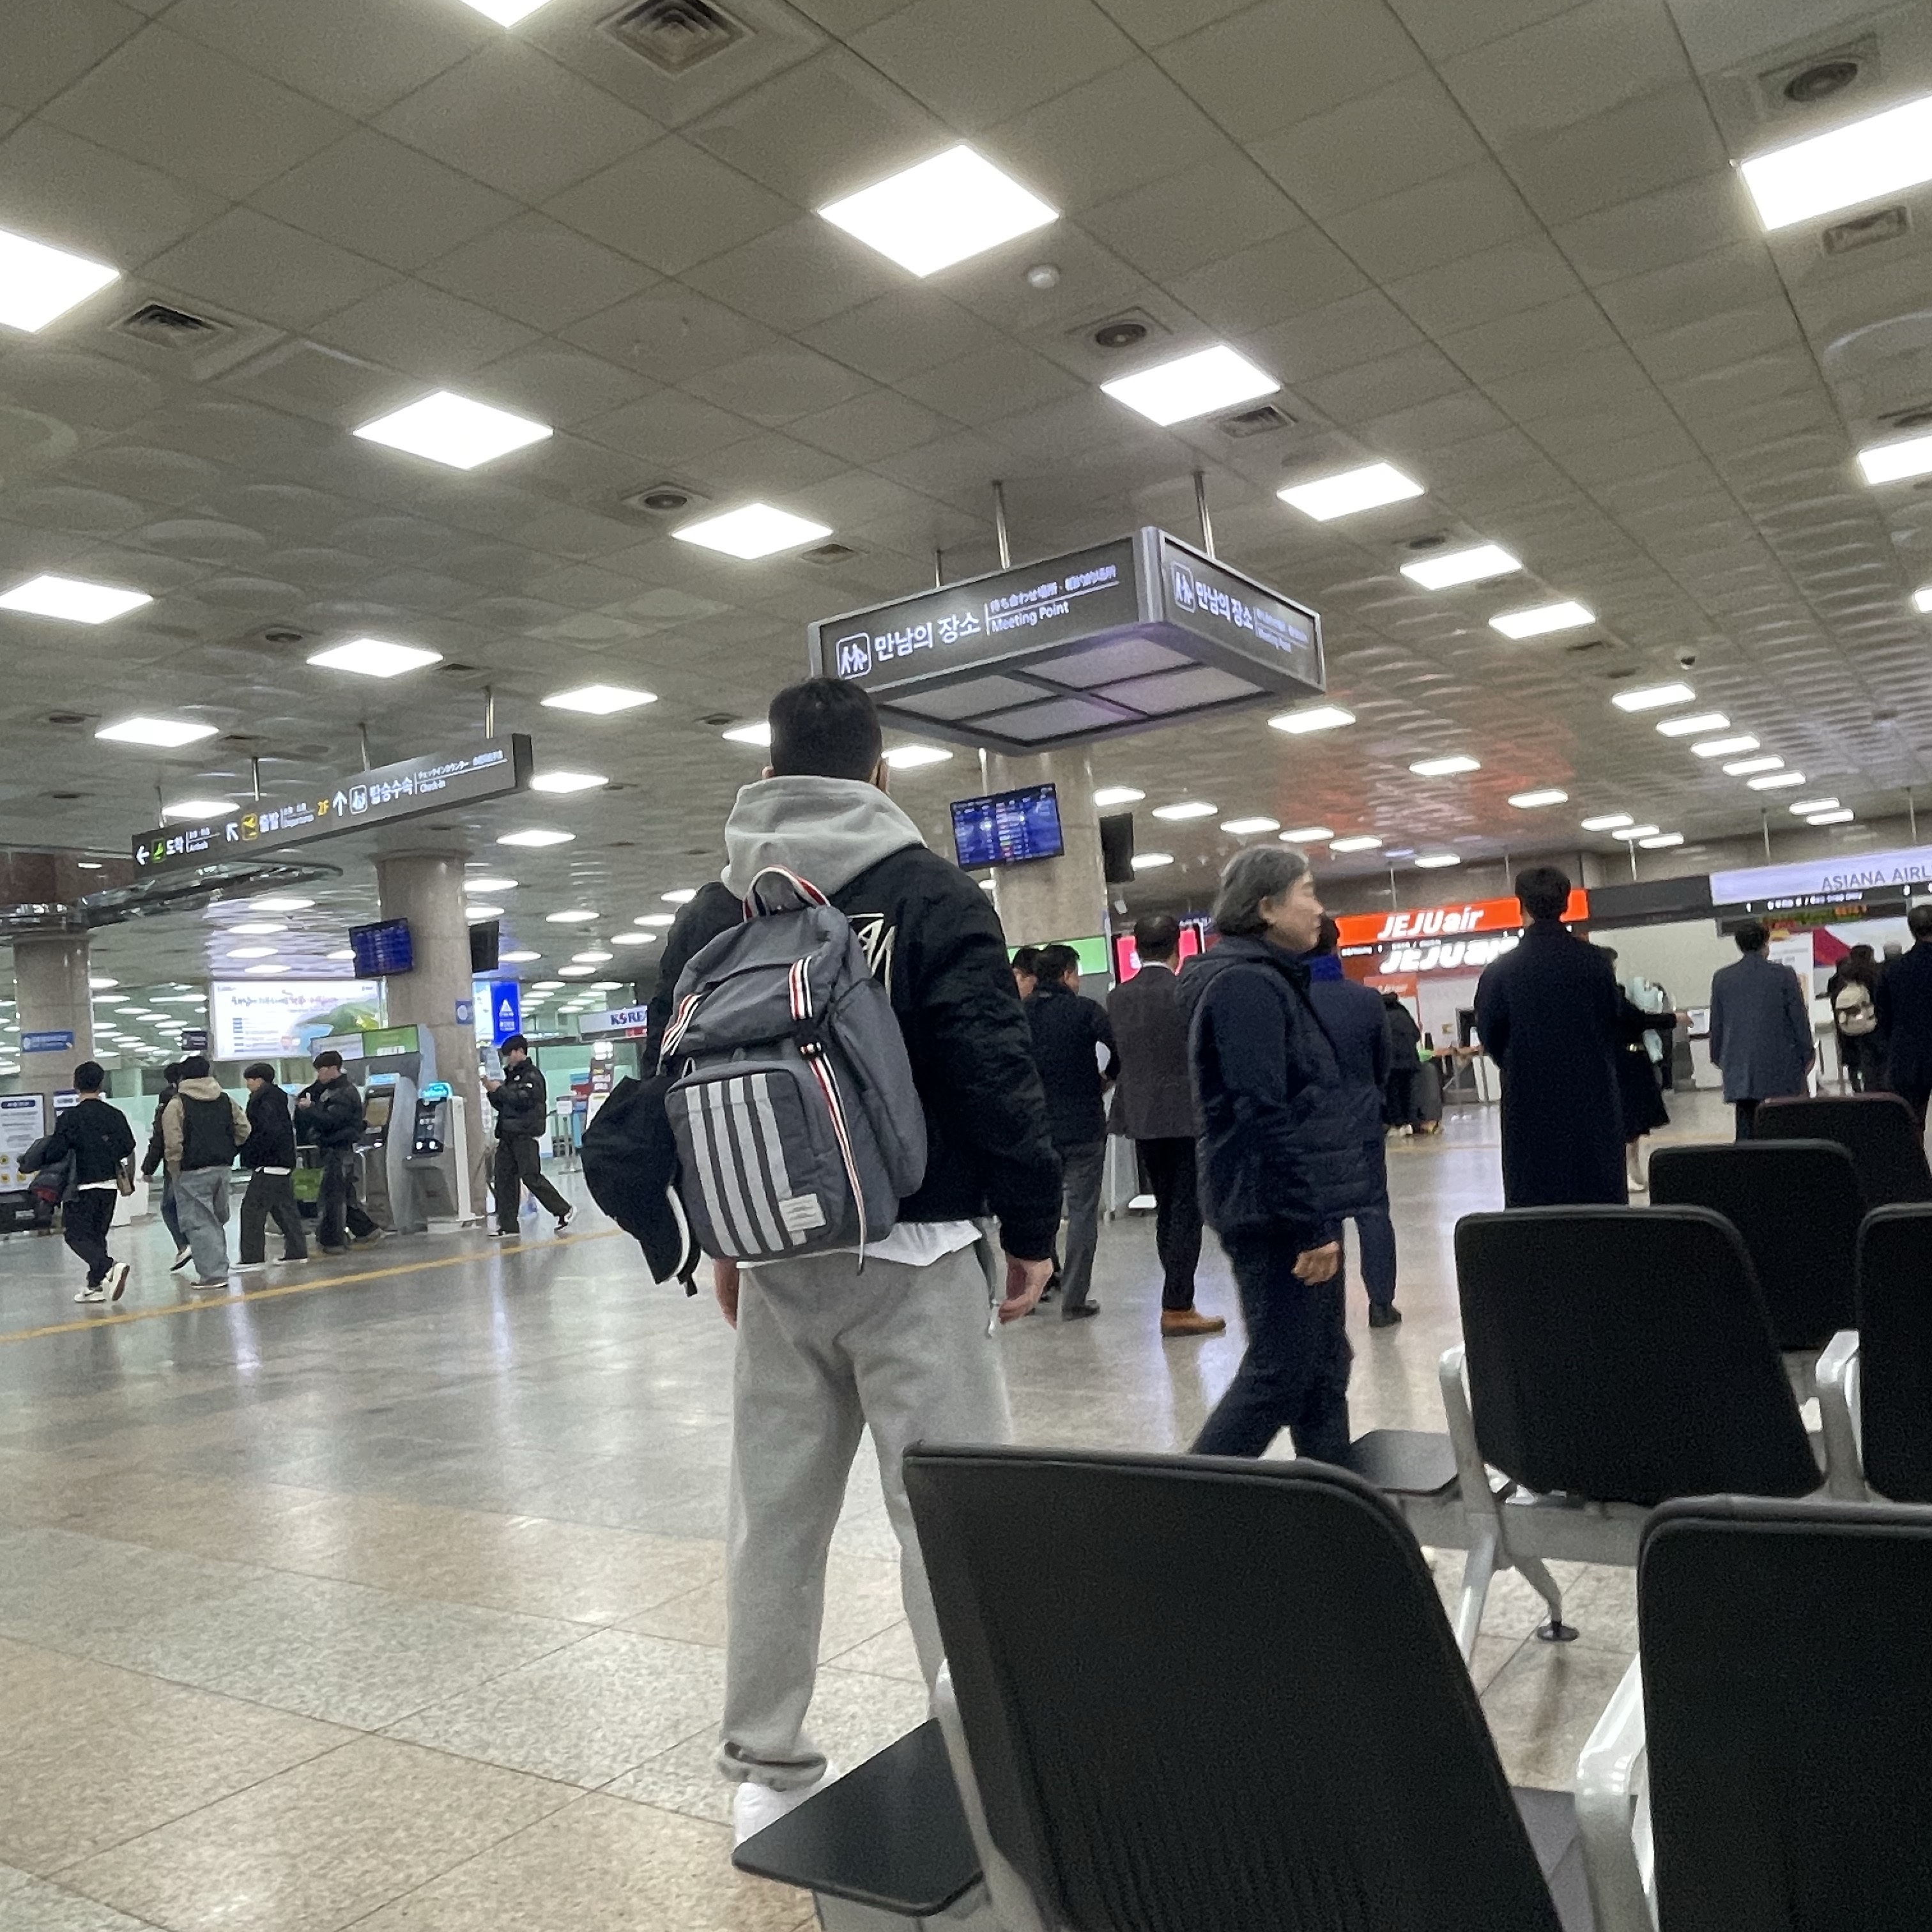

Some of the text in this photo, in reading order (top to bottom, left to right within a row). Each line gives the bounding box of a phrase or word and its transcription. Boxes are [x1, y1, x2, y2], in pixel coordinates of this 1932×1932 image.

[992, 601, 1070, 632] Meeting Point
[1195, 581, 1231, 622] 만남의
[1231, 597, 1254, 630] 장소
[874, 611, 981, 661] 만남의 장소
[1821, 864, 1932, 891] ASIANA AIRL
[1376, 906, 1484, 940] JEJUair
